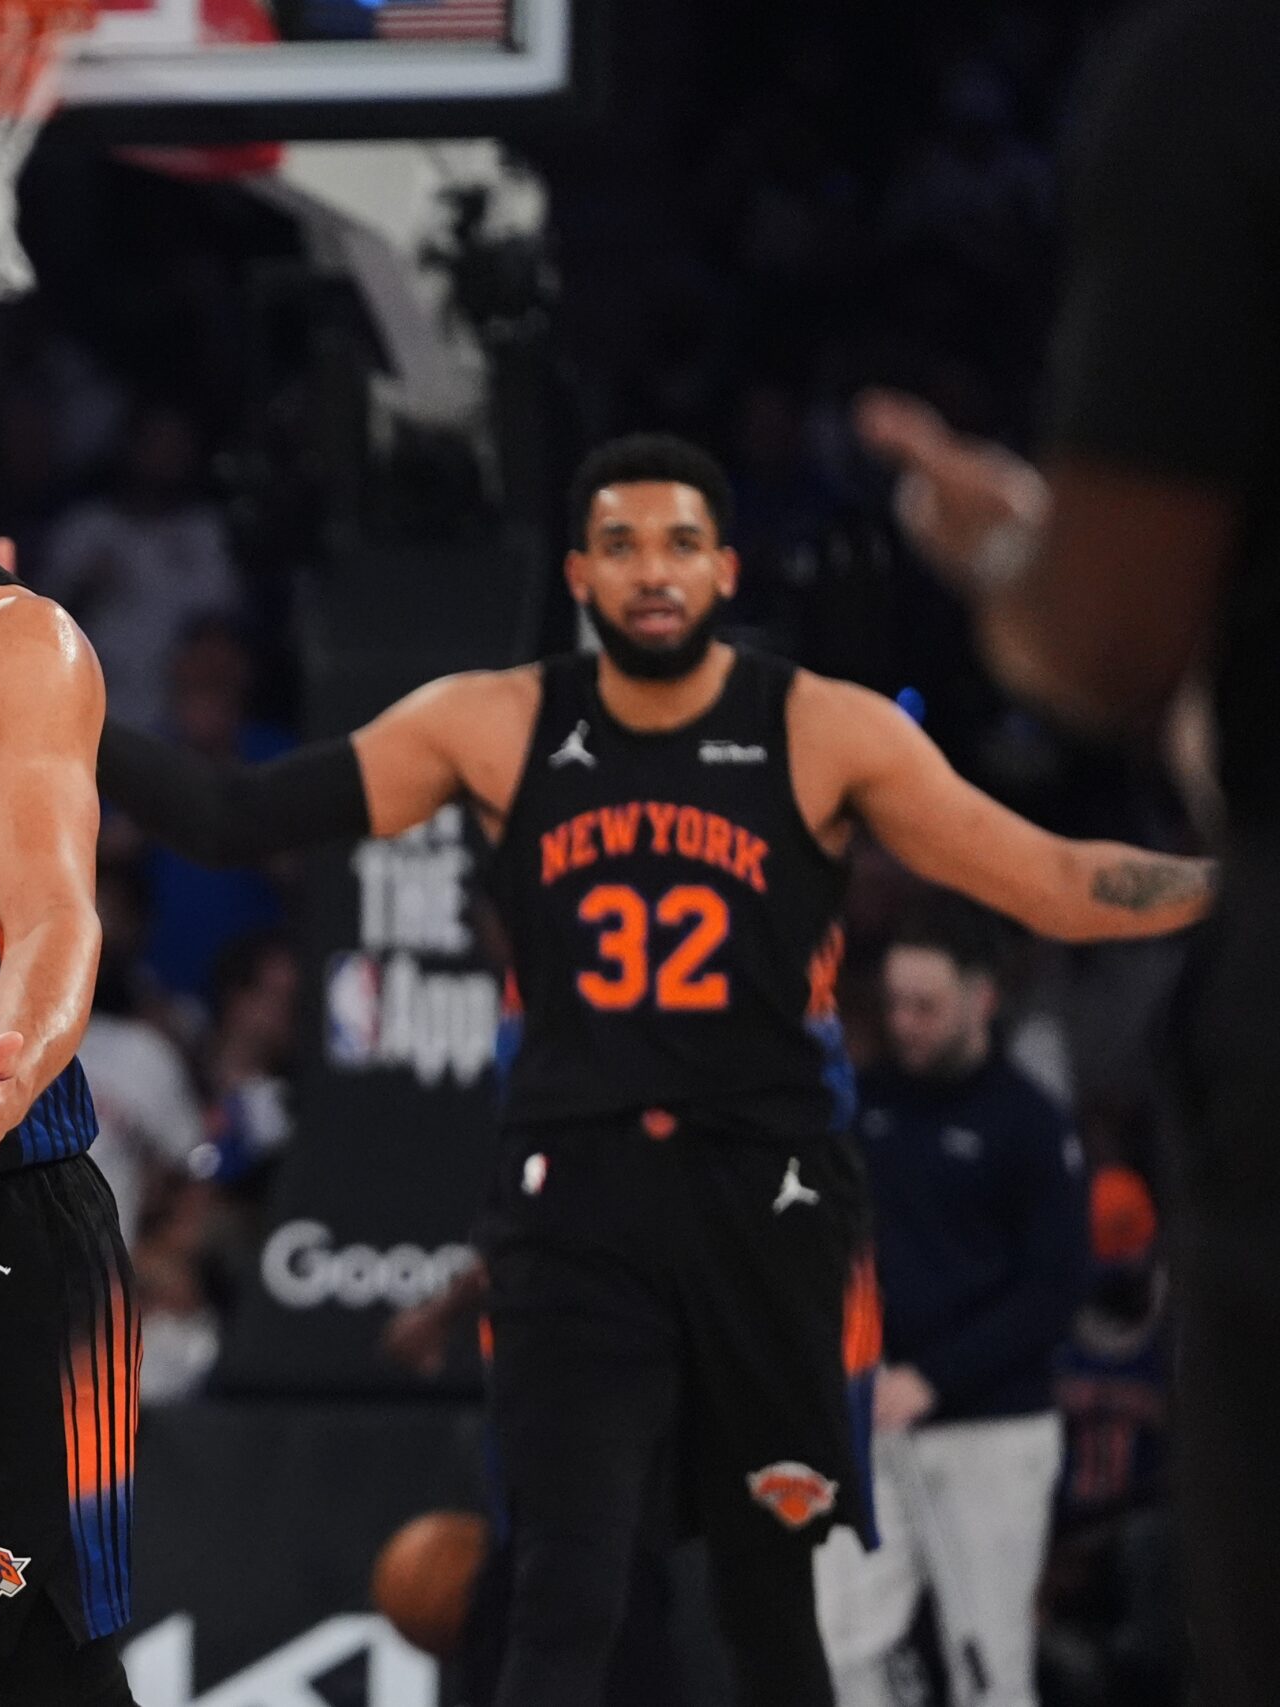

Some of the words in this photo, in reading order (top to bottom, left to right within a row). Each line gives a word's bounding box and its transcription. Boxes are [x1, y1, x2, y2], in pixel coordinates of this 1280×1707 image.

[539, 800, 643, 886] NEW
[645, 800, 770, 894] YORK
[576, 882, 732, 1012] 32
